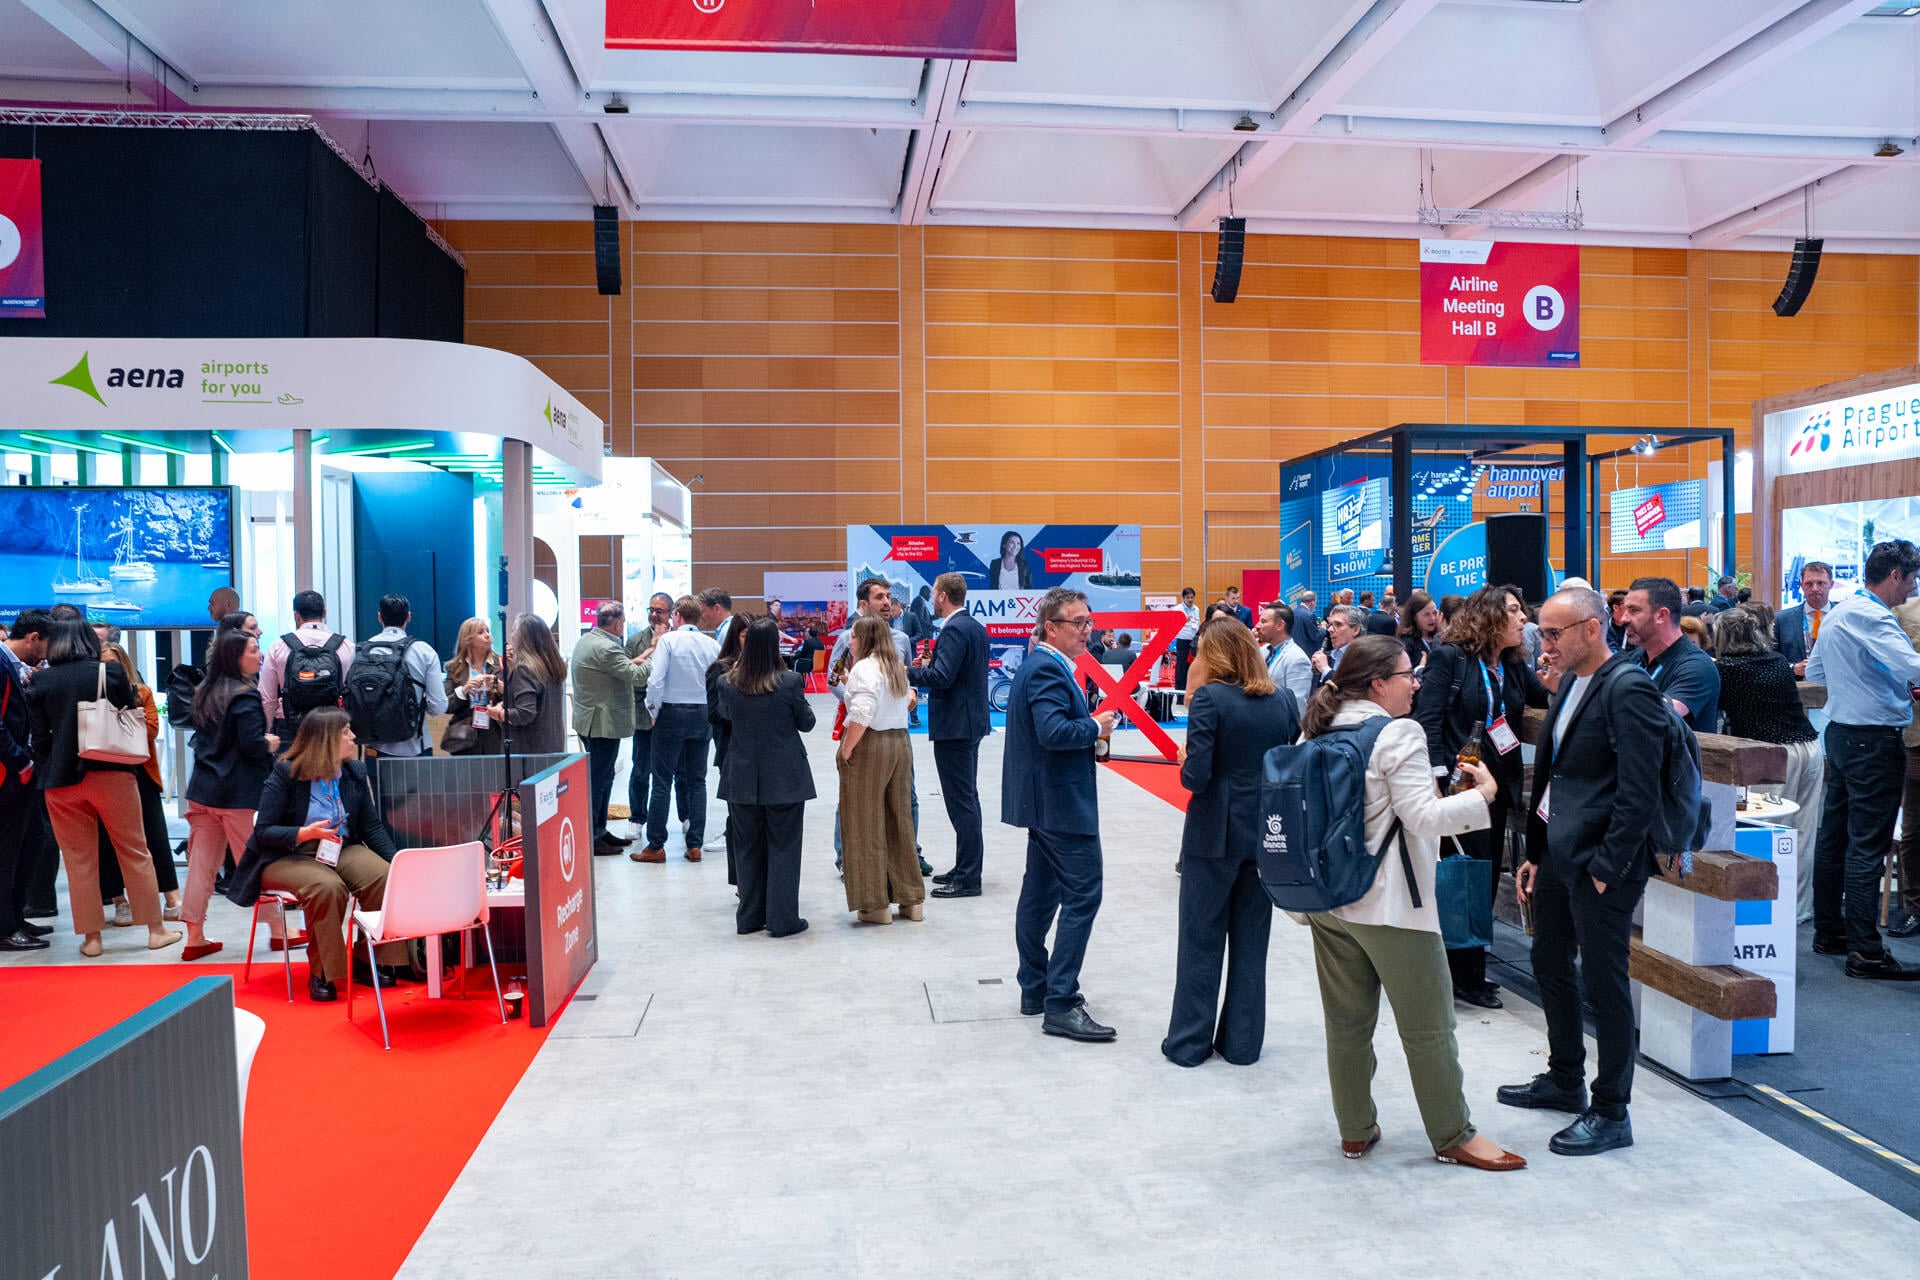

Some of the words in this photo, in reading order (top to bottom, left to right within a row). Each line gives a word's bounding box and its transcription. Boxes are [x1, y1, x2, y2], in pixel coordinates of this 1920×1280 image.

[1450, 277, 1498, 292] Airline
[1443, 298, 1504, 317] Meeting
[1536, 296, 1554, 321] B
[1452, 321, 1481, 336] Hall
[1486, 322, 1497, 336] B
[201, 360, 269, 376] airports
[107, 368, 184, 388] aena
[201, 380, 226, 394] for
[231, 382, 261, 397] you
[553, 406, 567, 428] aena
[1844, 399, 1920, 426] Prague
[1842, 419, 1920, 448] Airport
[1489, 465, 1565, 481] hannover
[1487, 484, 1541, 501] airport
[1411, 533, 1431, 544] AME
[1349, 550, 1360, 560] OF
[1412, 542, 1431, 553] GER
[1333, 558, 1372, 575] SHOW!
[1440, 562, 1456, 575] BE
[1459, 556, 1486, 572] PAR
[1454, 572, 1478, 587] THE
[998, 626, 1024, 635] belongs
[557, 888, 583, 928] Recharge
[564, 925, 579, 954] Zone
[1734, 944, 1777, 959] ARTA
